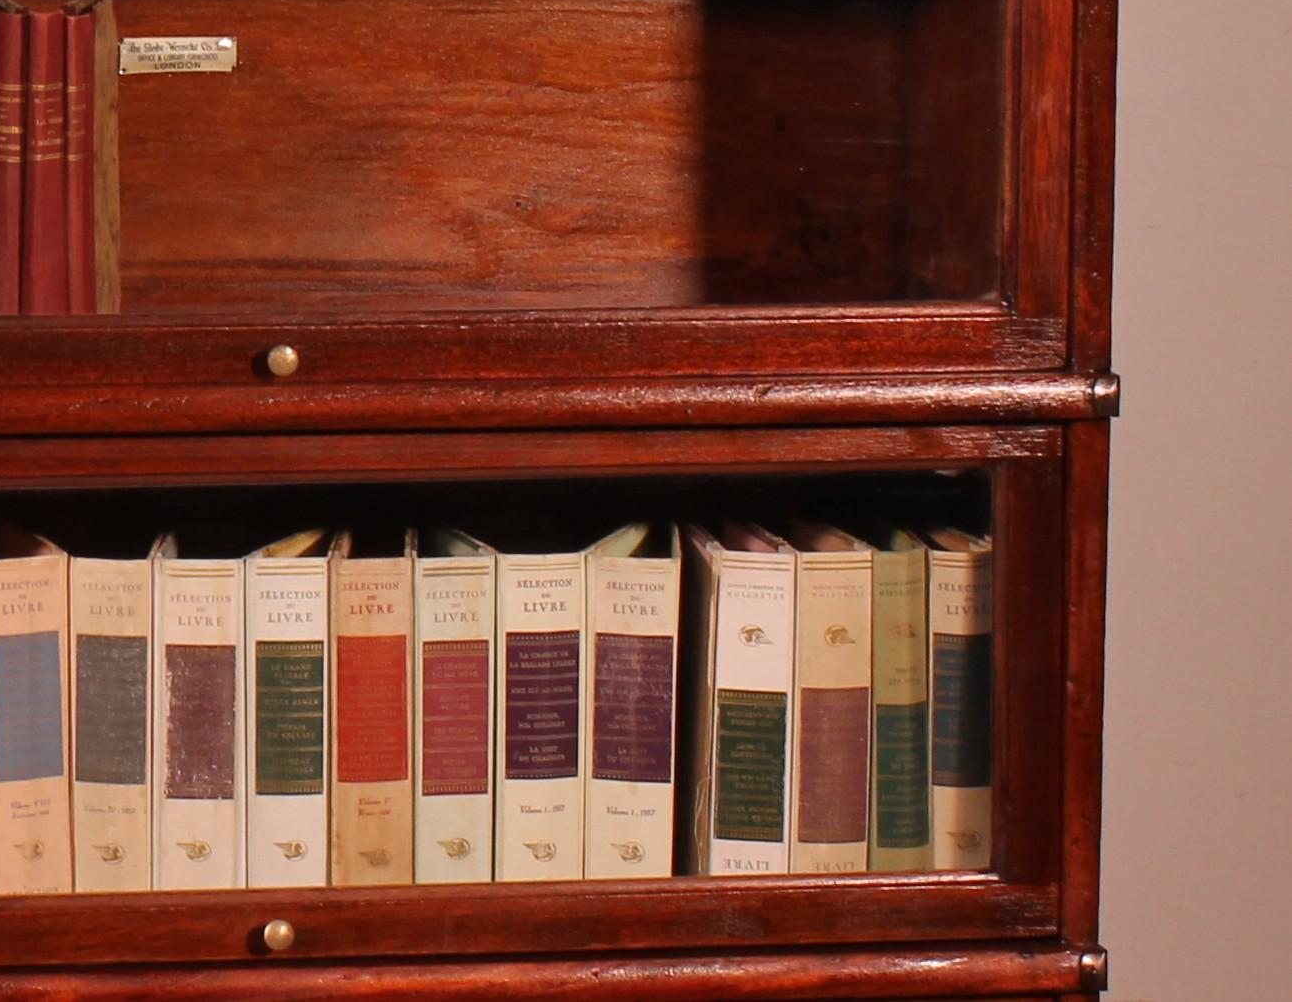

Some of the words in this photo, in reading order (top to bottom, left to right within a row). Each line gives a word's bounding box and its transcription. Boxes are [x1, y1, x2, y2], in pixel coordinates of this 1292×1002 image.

[154, 62, 201, 70] LONDON
[516, 578, 573, 589] SÉLECTION
[259, 589, 321, 600] SÉLECTION
[2, 602, 44, 615] LIVRE
[90, 605, 135, 616] LIVRE
[350, 604, 394, 615] LIVRE
[523, 601, 567, 612] LIVRE
[613, 604, 658, 616] LIVRE
[178, 616, 224, 627] LIVRE
[268, 612, 313, 623] LIVRE
[434, 612, 479, 623] LIVRE
[520, 805, 542, 814] Volume
[606, 806, 628, 816] Volume
[723, 859, 769, 871] LIVRE
